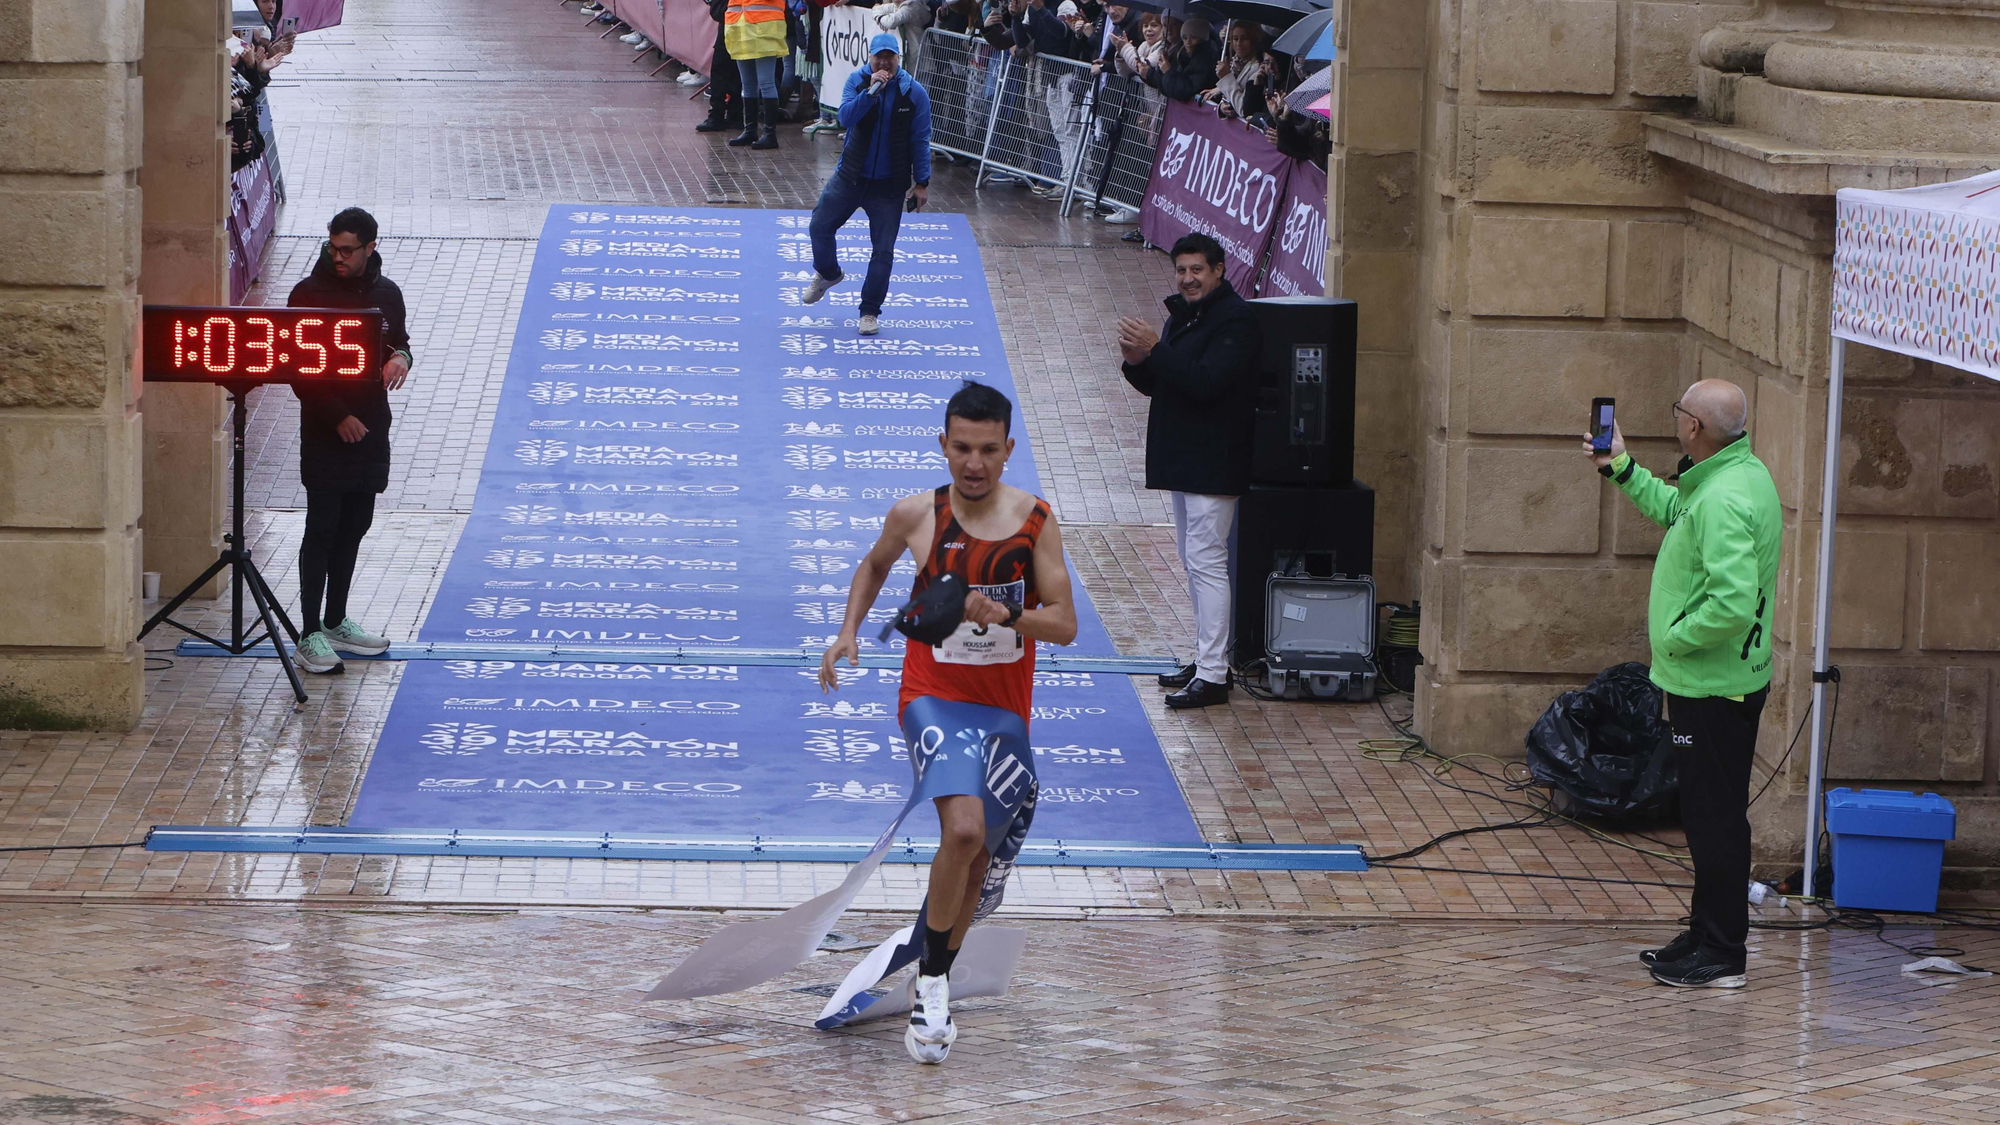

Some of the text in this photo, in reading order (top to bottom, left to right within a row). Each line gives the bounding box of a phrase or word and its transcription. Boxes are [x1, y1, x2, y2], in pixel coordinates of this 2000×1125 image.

[1185, 135, 1276, 233] IMDECO
[604, 268, 741, 276] IMDECO
[596, 313, 741, 322] IMDECO
[175, 317, 365, 374] 1:03:55
[779, 340, 827, 349] 39
[589, 364, 740, 373] IMDECO
[526, 390, 578, 398] 39
[781, 395, 832, 403] 39
[579, 421, 740, 429] IMDECO
[514, 449, 568, 458] 39
[575, 452, 738, 460] MARATÓN
[783, 453, 837, 462] 39
[568, 483, 740, 492] IMDECO
[565, 511, 671, 520] MEDIA
[558, 536, 739, 544] IMDECO
[545, 581, 739, 590] IMDECO
[464, 604, 530, 612] 39
[540, 607, 737, 615] MARATÓN
[443, 660, 516, 670] 39
[514, 698, 740, 710] IMDECO
[507, 729, 649, 739] MEDIA
[419, 734, 497, 746] 39
[507, 738, 738, 750] MARATÓN
[803, 741, 880, 752] 39
[504, 747, 646, 756] CÓRDOBA
[494, 779, 742, 792] IMDECO
